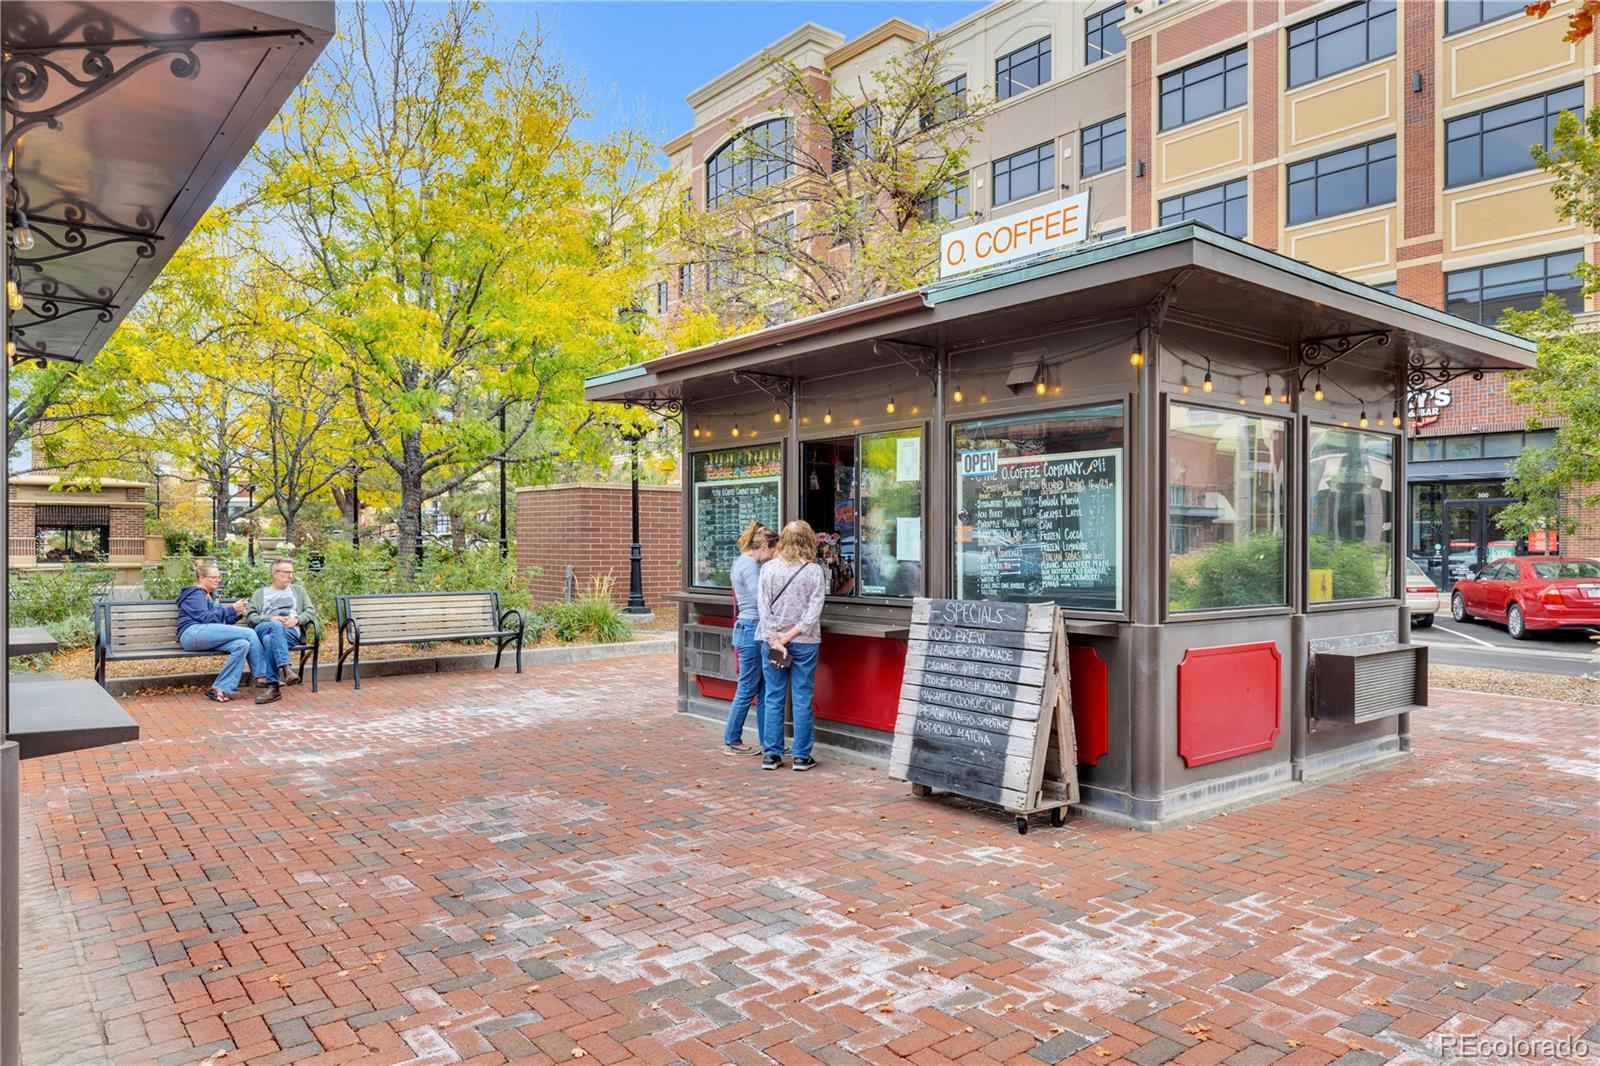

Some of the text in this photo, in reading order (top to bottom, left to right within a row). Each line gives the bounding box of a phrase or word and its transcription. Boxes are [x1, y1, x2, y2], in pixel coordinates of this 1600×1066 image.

[946, 204, 1080, 267] O. COFFEE
[1420, 407, 1440, 417] BAR
[964, 452, 996, 473] OPEN
[1043, 459, 1083, 478] COMPANY
[943, 602, 1004, 624] SPECIALS
[929, 627, 986, 645] COLD BREW
[929, 644, 969, 657] LAVENDER
[926, 661, 958, 672] CARAMEL
[982, 667, 1013, 681] CIDER
[949, 678, 980, 691] DOUGH
[983, 682, 1011, 697] MOCHA
[954, 695, 984, 710] COOKIE
[985, 700, 1005, 714] CHAI
[918, 704, 944, 719] PEACH
[946, 710, 975, 726] MANGO
[916, 719, 992, 746] PISTACHIO MATCHA
